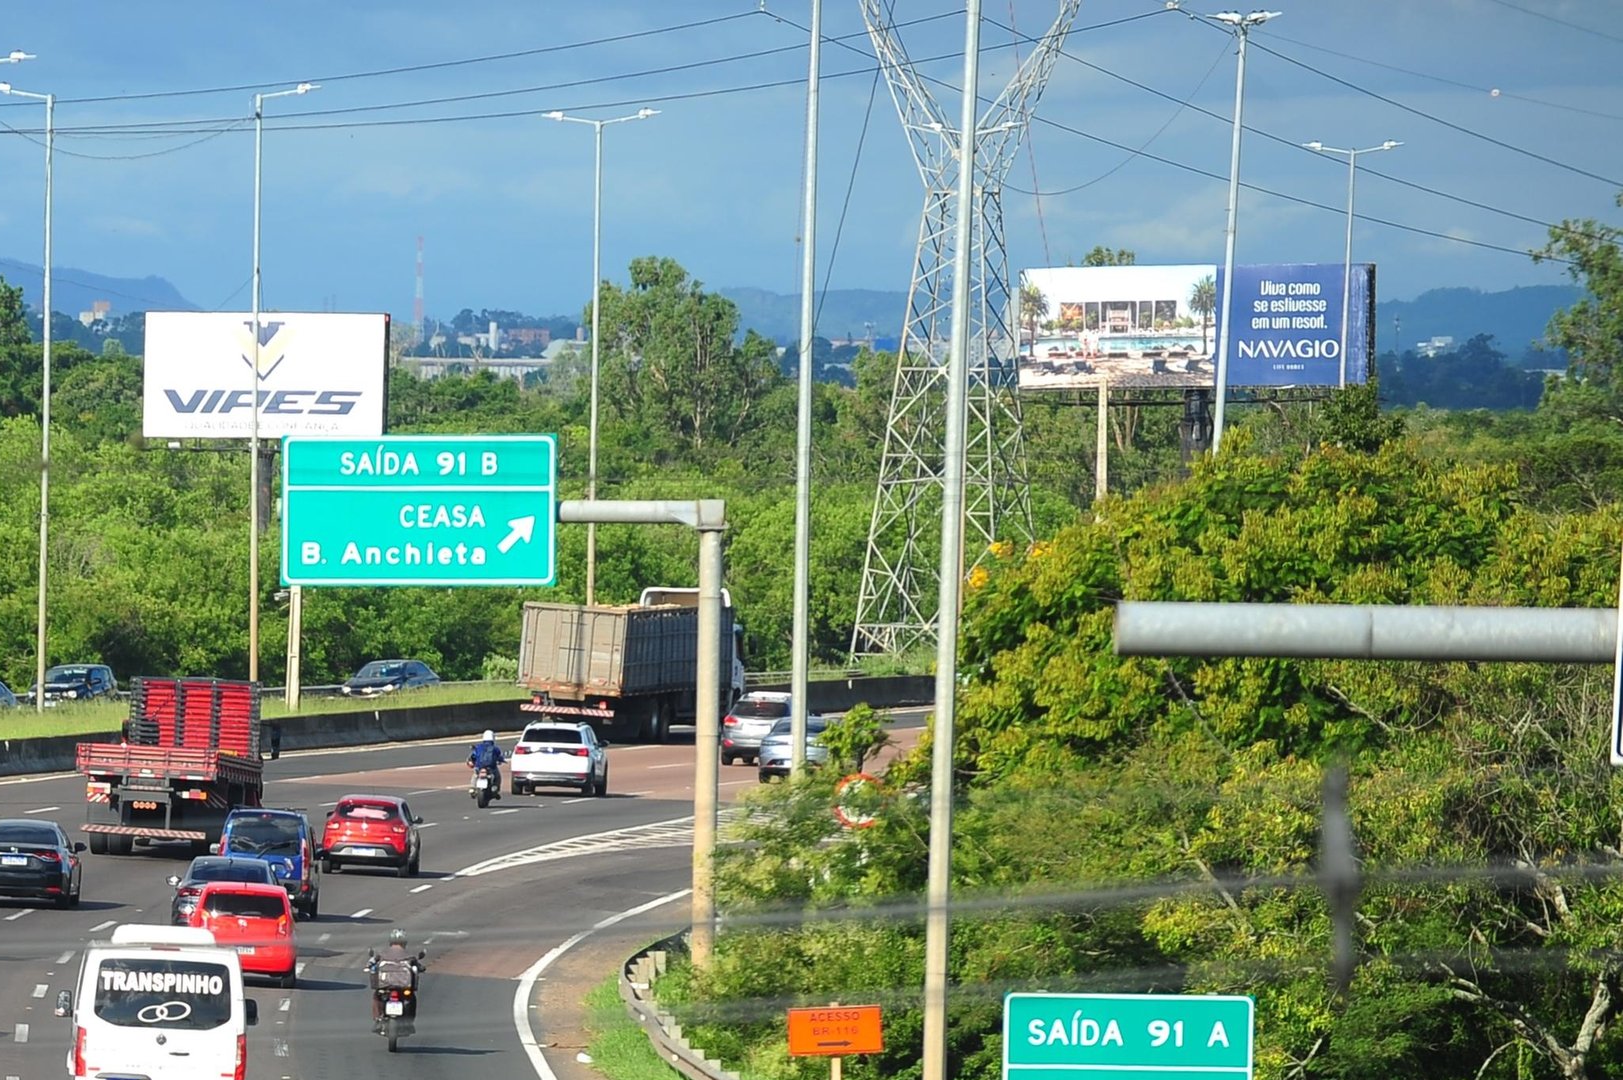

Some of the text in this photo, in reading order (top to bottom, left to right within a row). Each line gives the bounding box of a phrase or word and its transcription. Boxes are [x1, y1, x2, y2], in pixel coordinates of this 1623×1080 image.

[1260, 280, 1321, 296] Viva como
[1253, 297, 1327, 312] se estivesse
[1251, 314, 1328, 329] em um resort.
[1239, 339, 1339, 359] NAVAGIO
[163, 388, 363, 415] VIPES
[339, 444, 498, 476] SAÍDA 91 B
[399, 504, 487, 529] CEASA
[301, 541, 488, 566] B. Anchieta
[101, 970, 223, 995] TRANSPINHO
[810, 1011, 861, 1022] ACESSO
[812, 1026, 860, 1036] BR-116
[1027, 1009, 1231, 1049] SAÍDA 91 A
